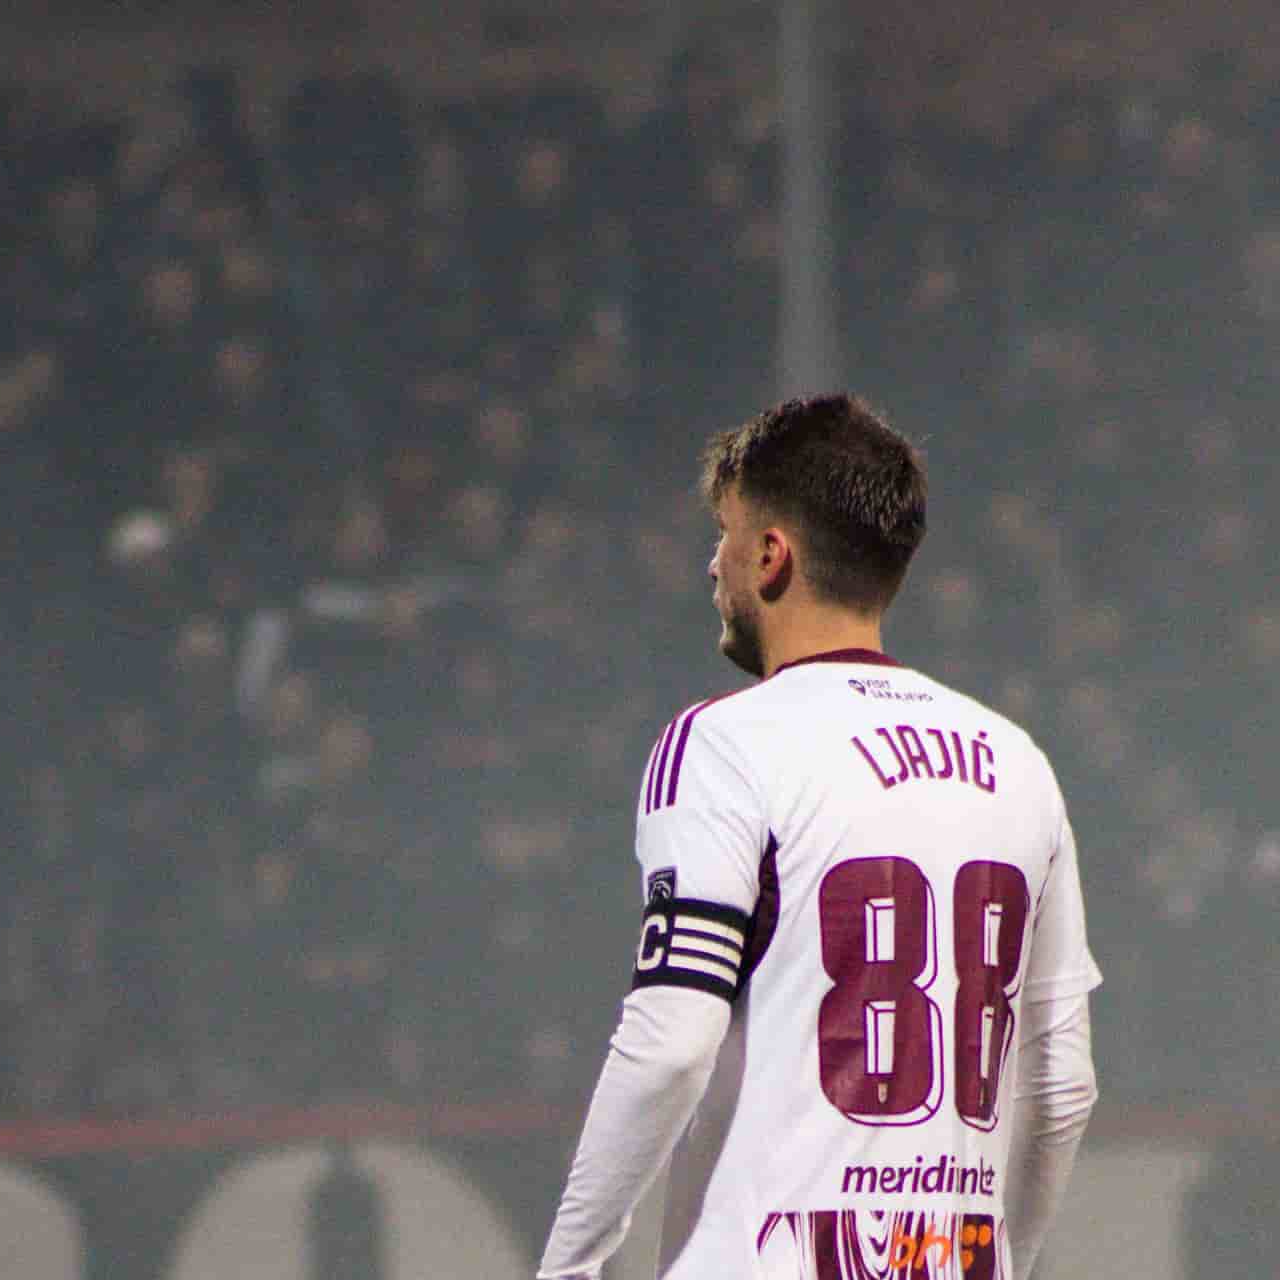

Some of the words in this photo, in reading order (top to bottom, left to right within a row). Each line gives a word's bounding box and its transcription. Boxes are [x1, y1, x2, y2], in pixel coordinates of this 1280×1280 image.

[850, 725, 996, 794] LJAJIĆ
[637, 913, 668, 971] C
[818, 856, 1031, 1132] 88
